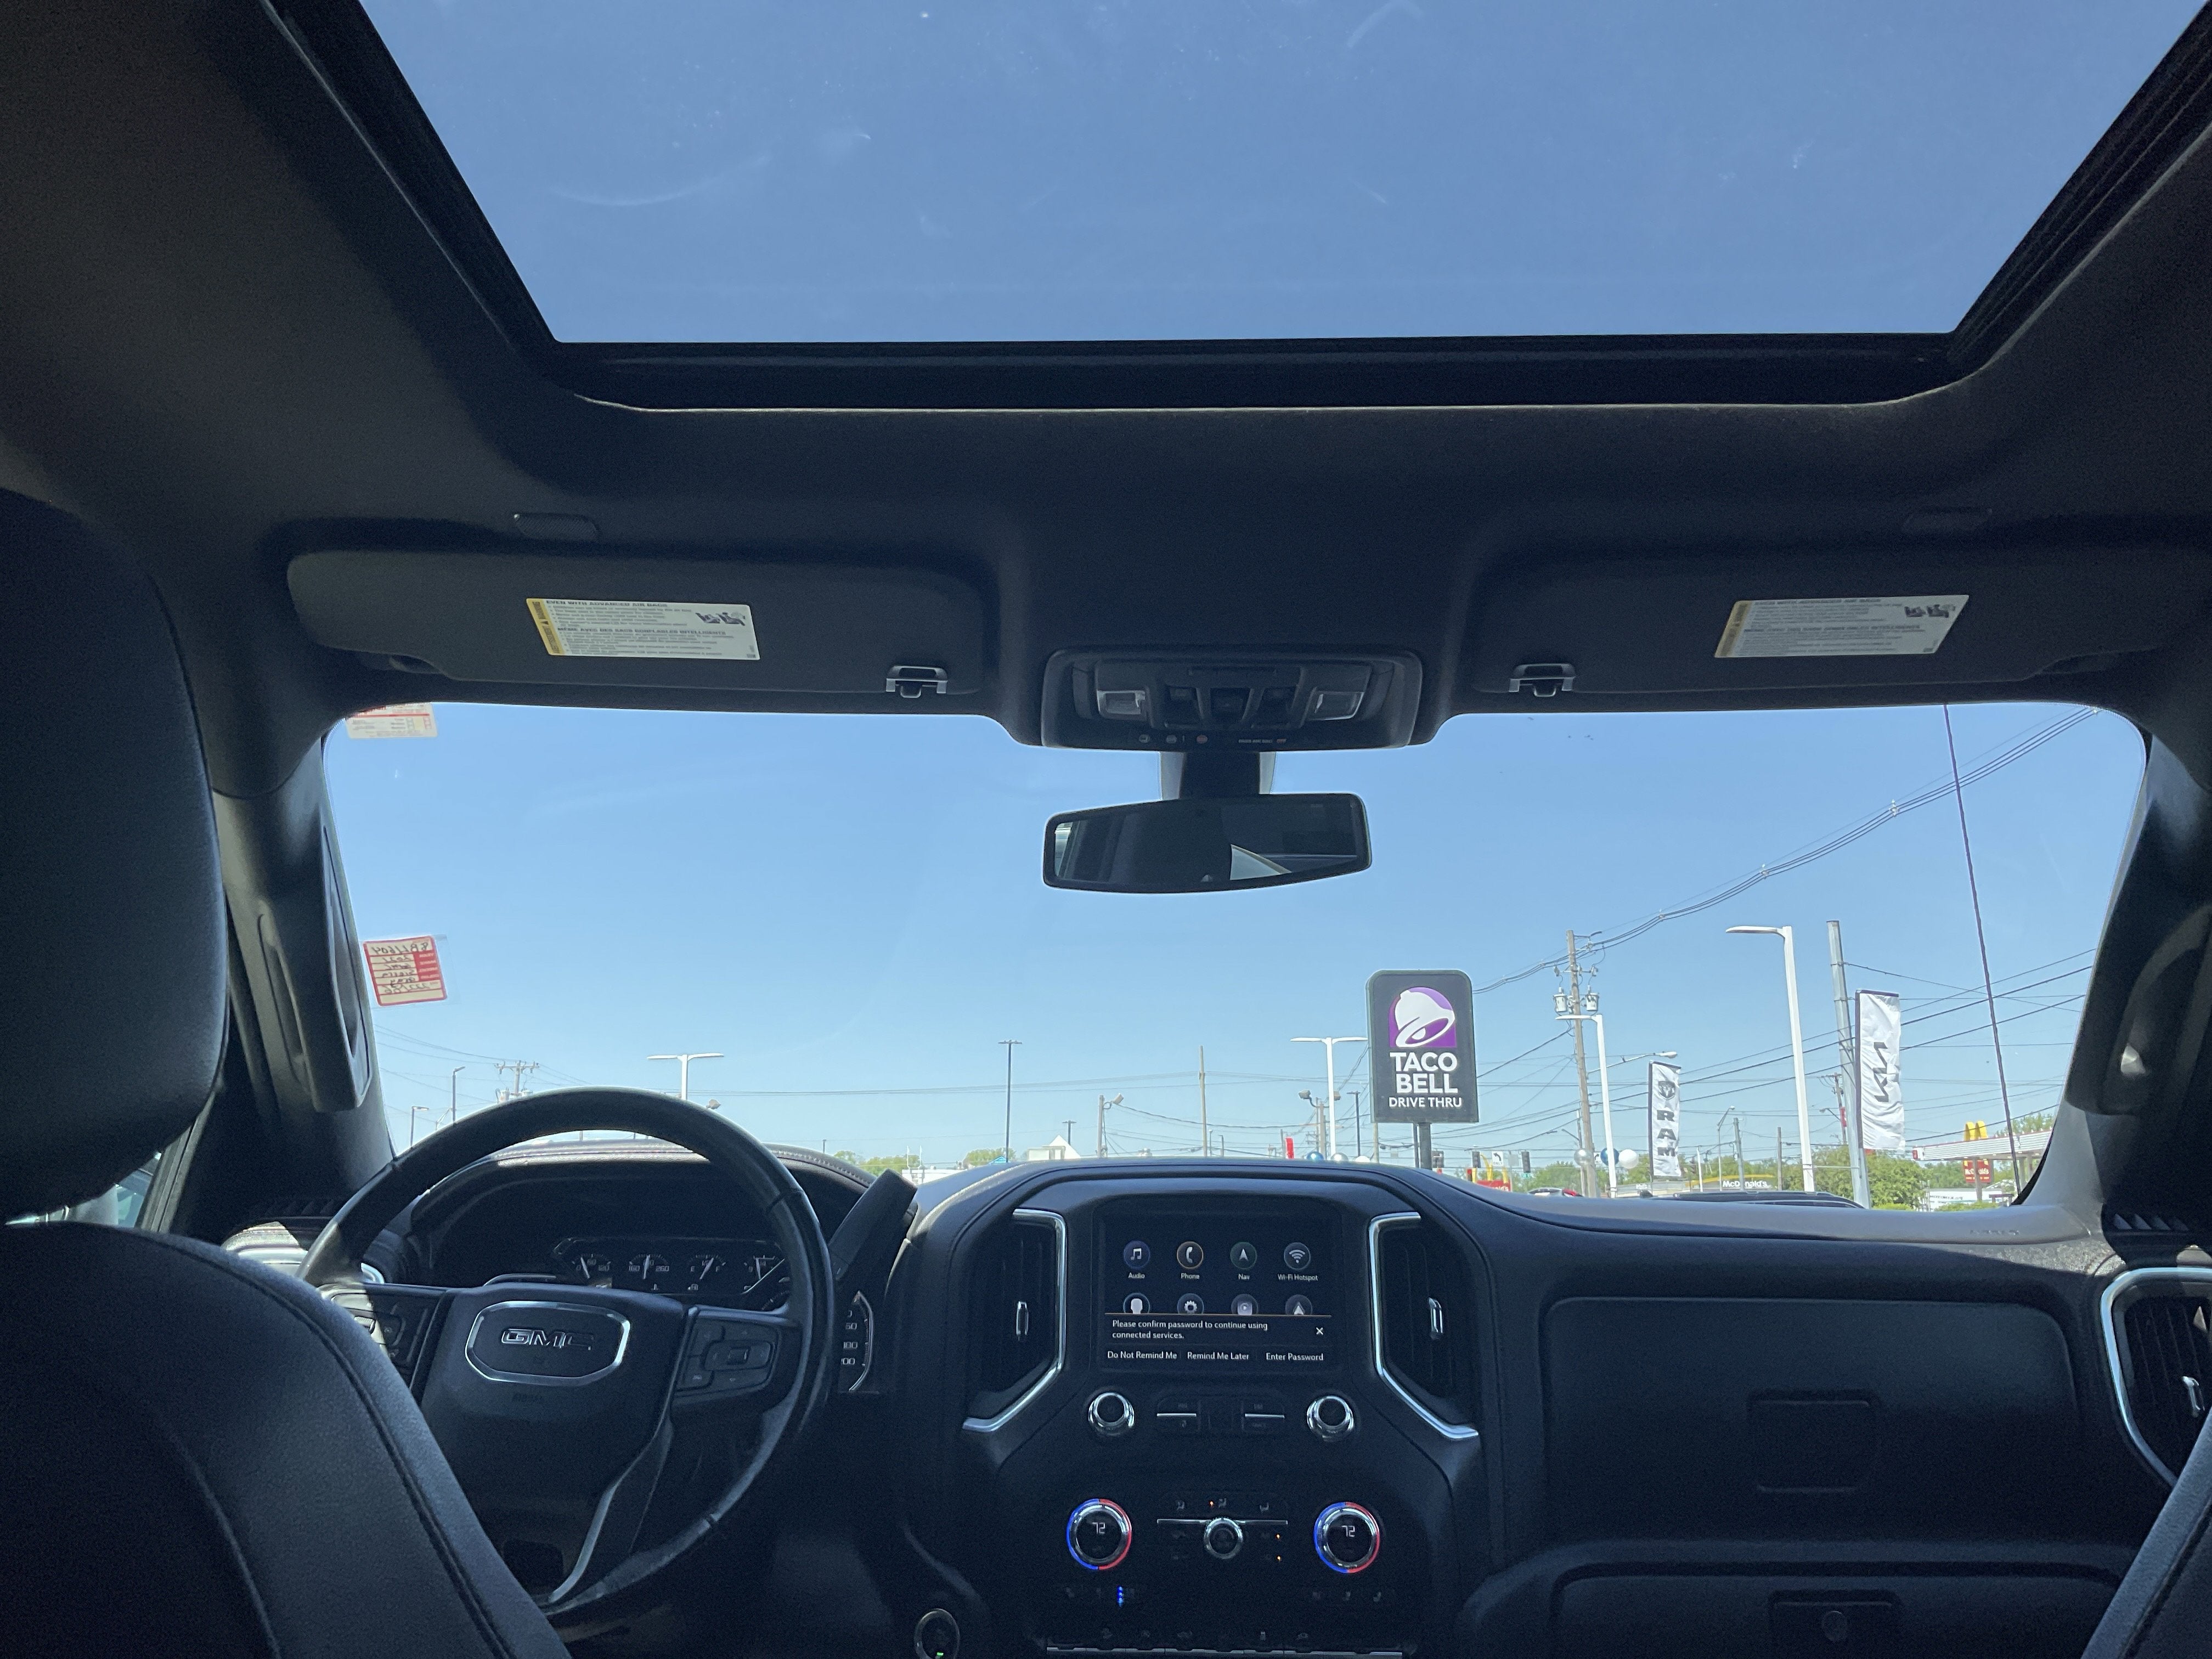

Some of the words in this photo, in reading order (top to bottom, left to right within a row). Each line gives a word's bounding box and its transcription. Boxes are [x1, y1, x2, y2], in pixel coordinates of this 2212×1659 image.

[1389, 1052, 1458, 1072] TACO
[1396, 1073, 1458, 1093] BELL
[1389, 1097, 1425, 1108] DRIVE
[1427, 1097, 1462, 1108] THRU
[1112, 1319, 1136, 1328] Please
[1168, 1320, 1203, 1329] password
[1248, 1322, 1268, 1331] using
[1112, 1330, 1152, 1339] connected
[1107, 1351, 1119, 1359] Do
[1136, 1351, 1164, 1359] Remind
[1165, 1351, 1177, 1359] Me
[1187, 1351, 1215, 1359] Remind
[1217, 1352, 1229, 1360] Me
[1231, 1352, 1249, 1360] Later
[1266, 1352, 1286, 1361] Enter
[1288, 1352, 1324, 1361] Password
[1092, 1522, 1105, 1534] 72
[1341, 1525, 1355, 1537] 72
